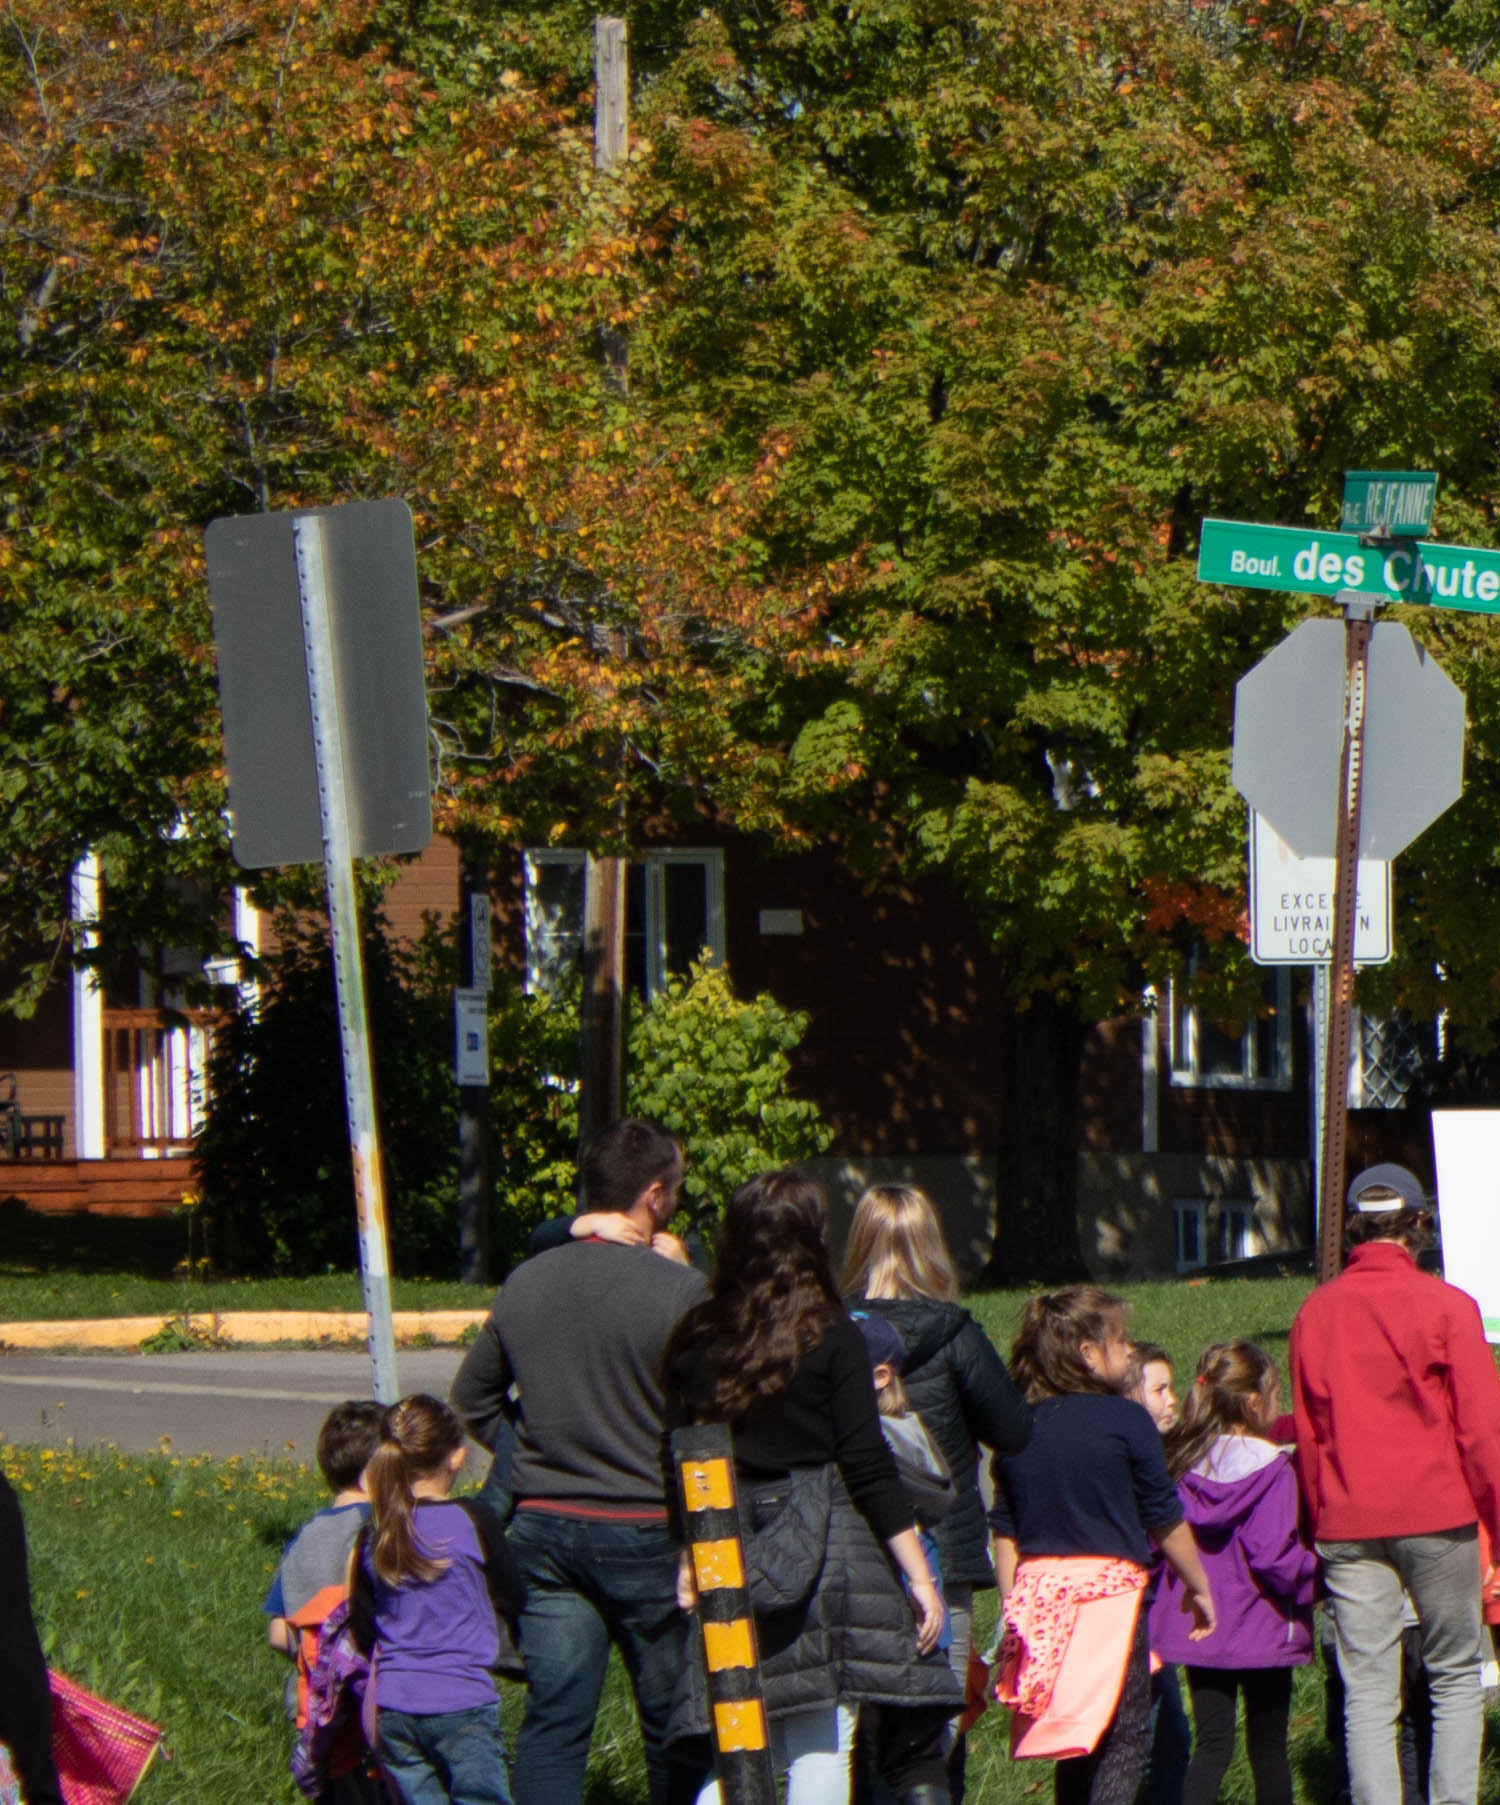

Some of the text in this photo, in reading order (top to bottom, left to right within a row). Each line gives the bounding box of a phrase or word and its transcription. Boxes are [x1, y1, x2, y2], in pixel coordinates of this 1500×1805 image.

[1231, 549, 1282, 577] Boul.
[1293, 541, 1366, 586] des
[1273, 915, 1370, 933] LIVRAIN
[1288, 938, 1335, 955] LOCA
